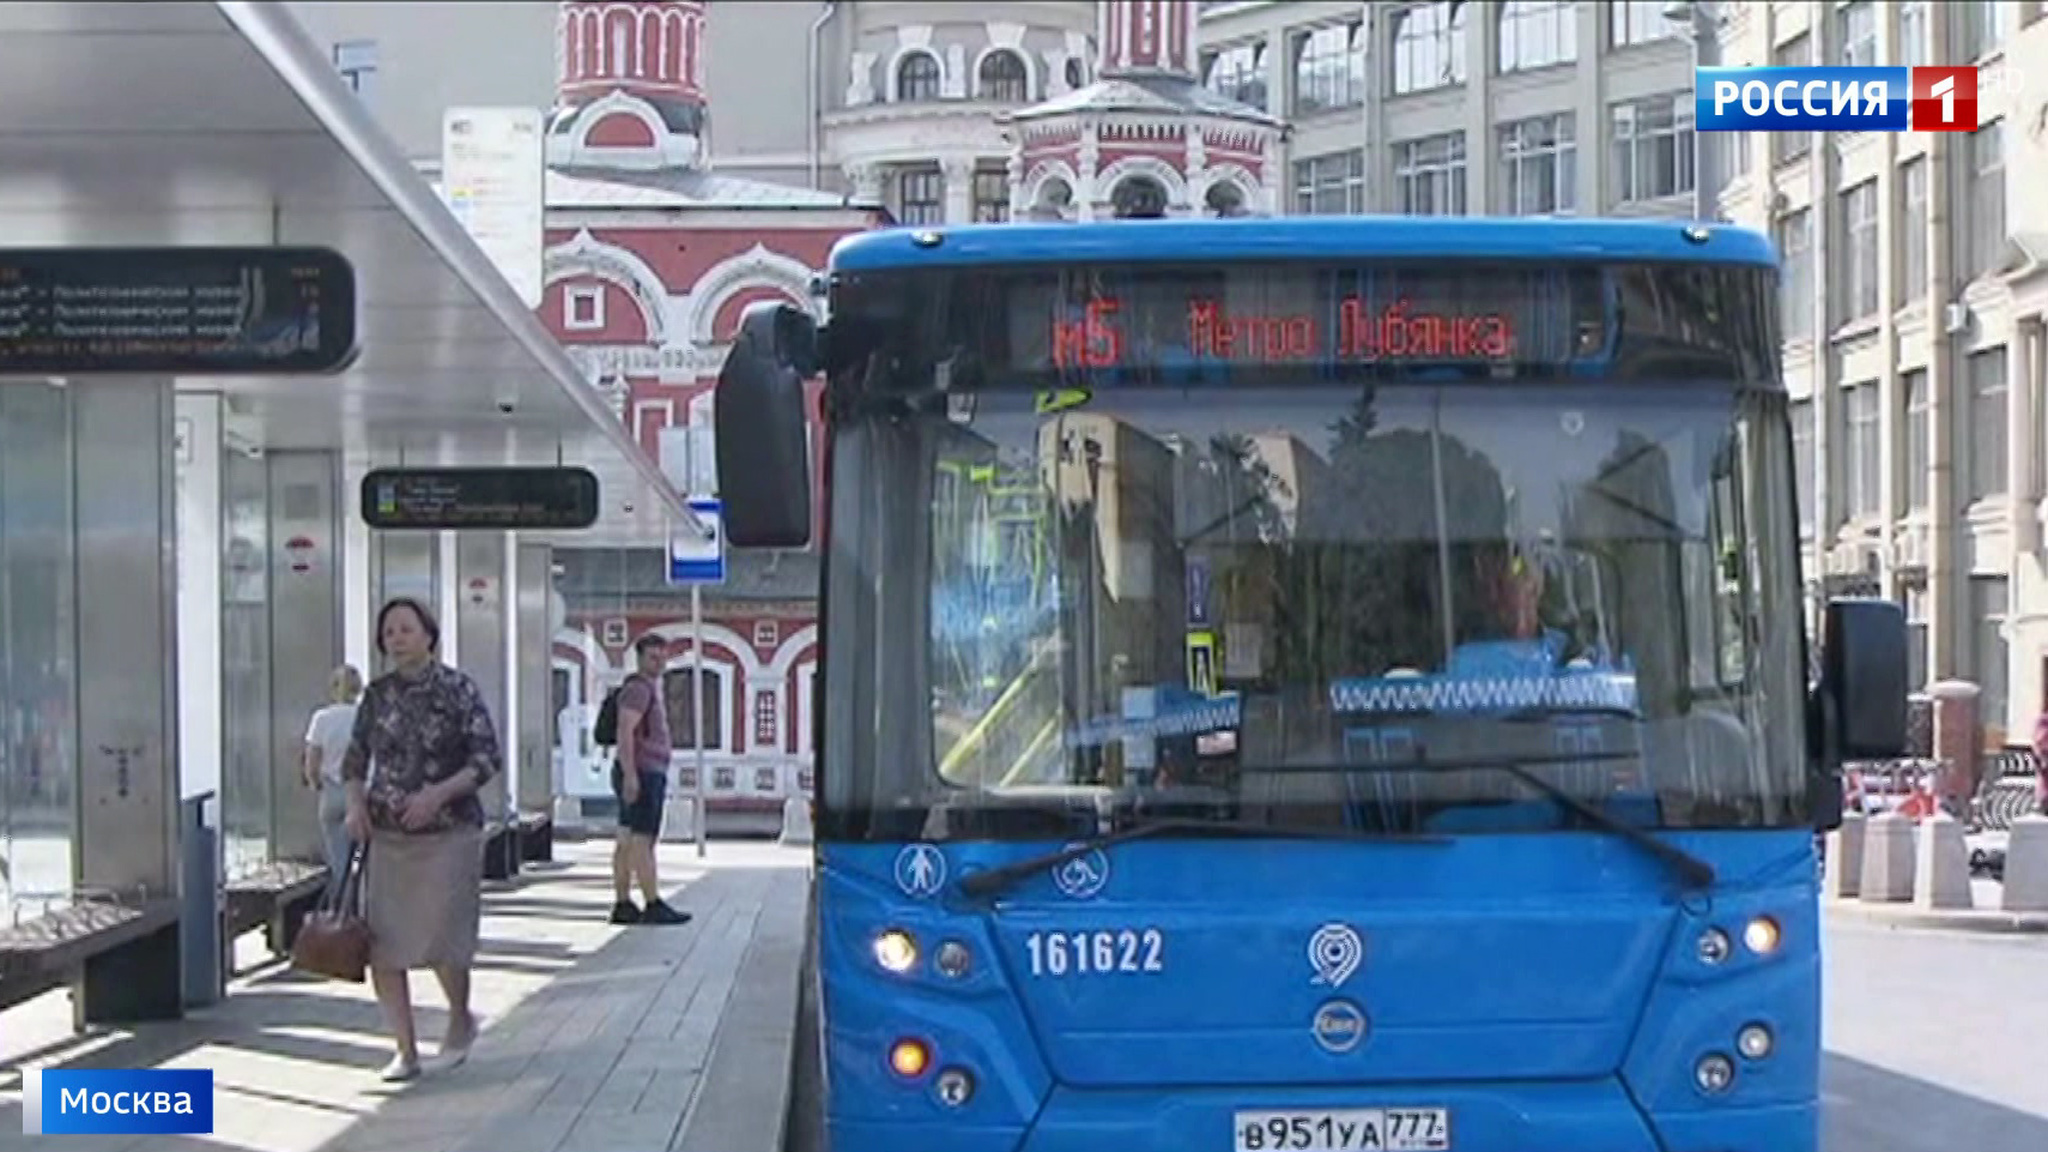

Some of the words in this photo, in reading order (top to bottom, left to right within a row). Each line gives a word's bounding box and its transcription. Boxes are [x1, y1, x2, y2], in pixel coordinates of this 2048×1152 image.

[1053, 298, 1119, 367] м5
[1190, 298, 1315, 359] Метро
[1339, 296, 1513, 363] Лубянка
[1026, 928, 1163, 976] 161622
[1245, 1114, 1380, 1151] В951УА
[1388, 1112, 1438, 1137] 777
